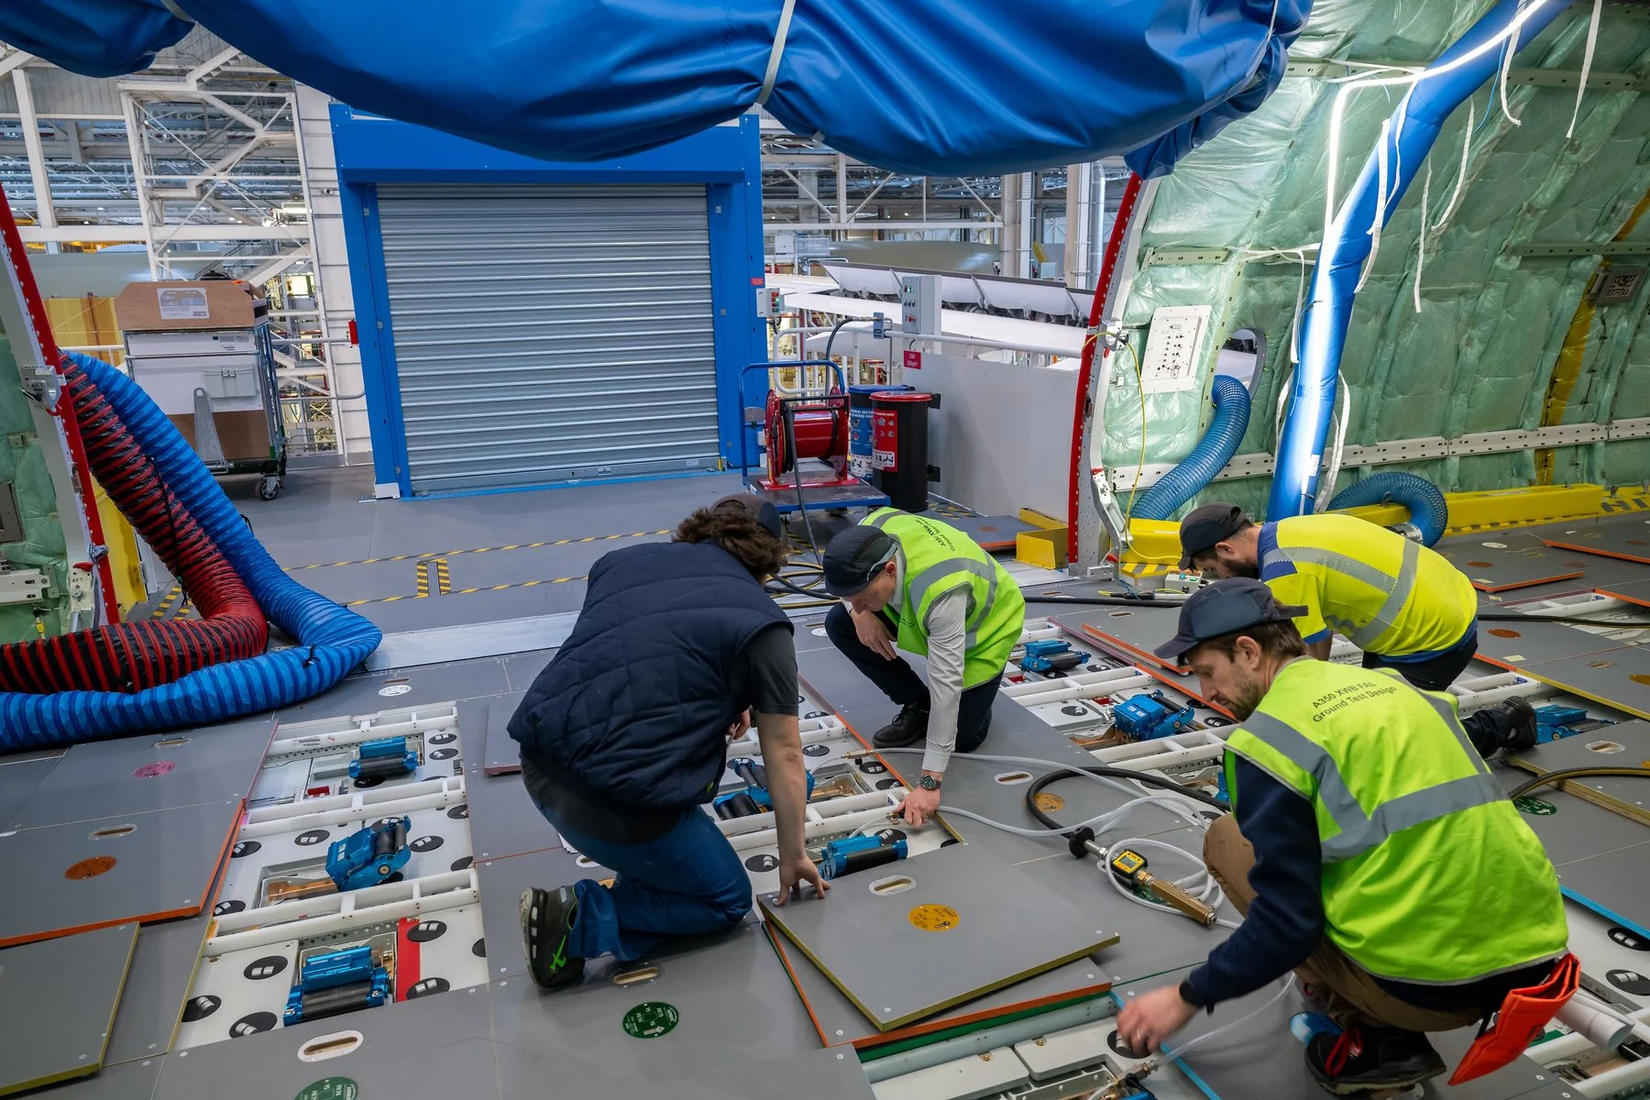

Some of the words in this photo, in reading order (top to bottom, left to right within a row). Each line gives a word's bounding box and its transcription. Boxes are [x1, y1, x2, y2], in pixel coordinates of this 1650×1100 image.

[1312, 693, 1337, 709] A350
[1334, 685, 1359, 696] XWB
[1357, 681, 1377, 690] FAL
[1312, 699, 1348, 723] Ground
[1346, 693, 1367, 704] Test
[1366, 686, 1398, 698] Design
